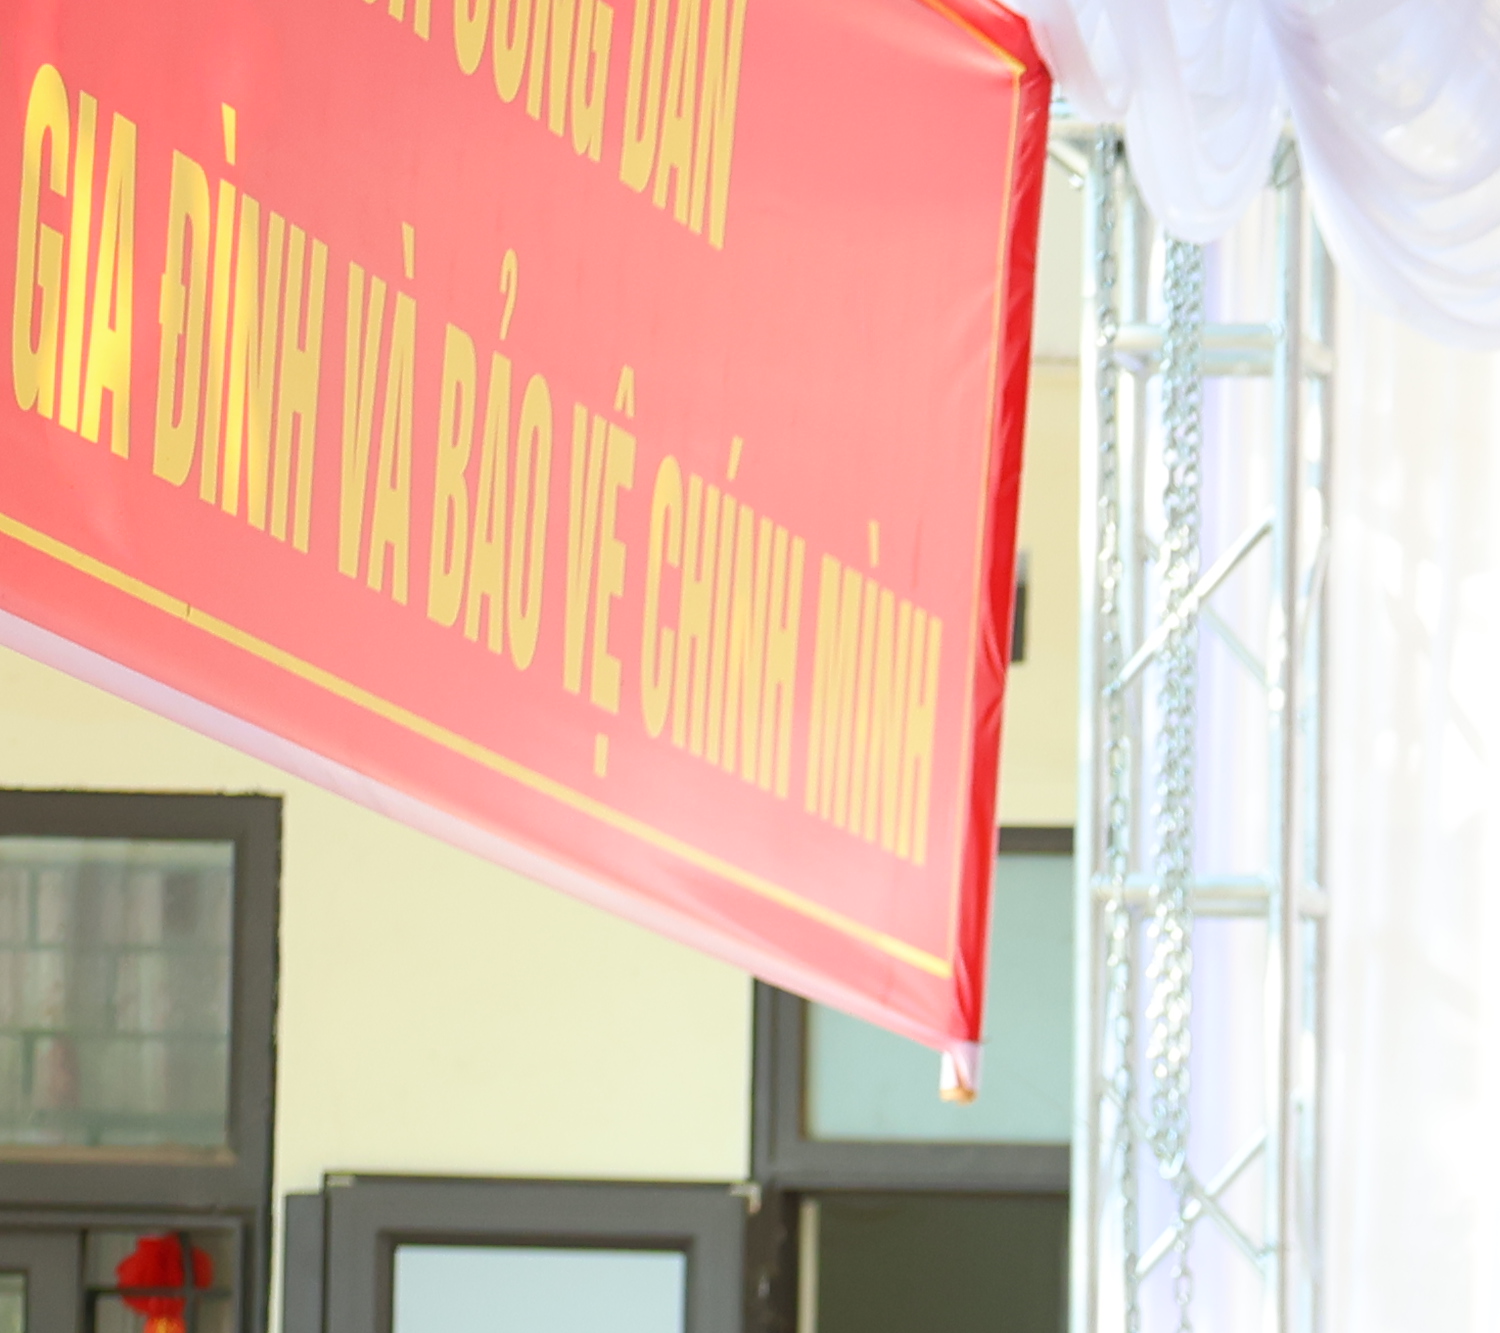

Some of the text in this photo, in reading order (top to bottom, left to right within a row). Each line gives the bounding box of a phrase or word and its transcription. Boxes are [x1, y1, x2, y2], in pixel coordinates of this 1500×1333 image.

[11, 63, 943, 867] GIA ĐÌNH VÀ BẢO VỆ CHÍNH MÌNH
